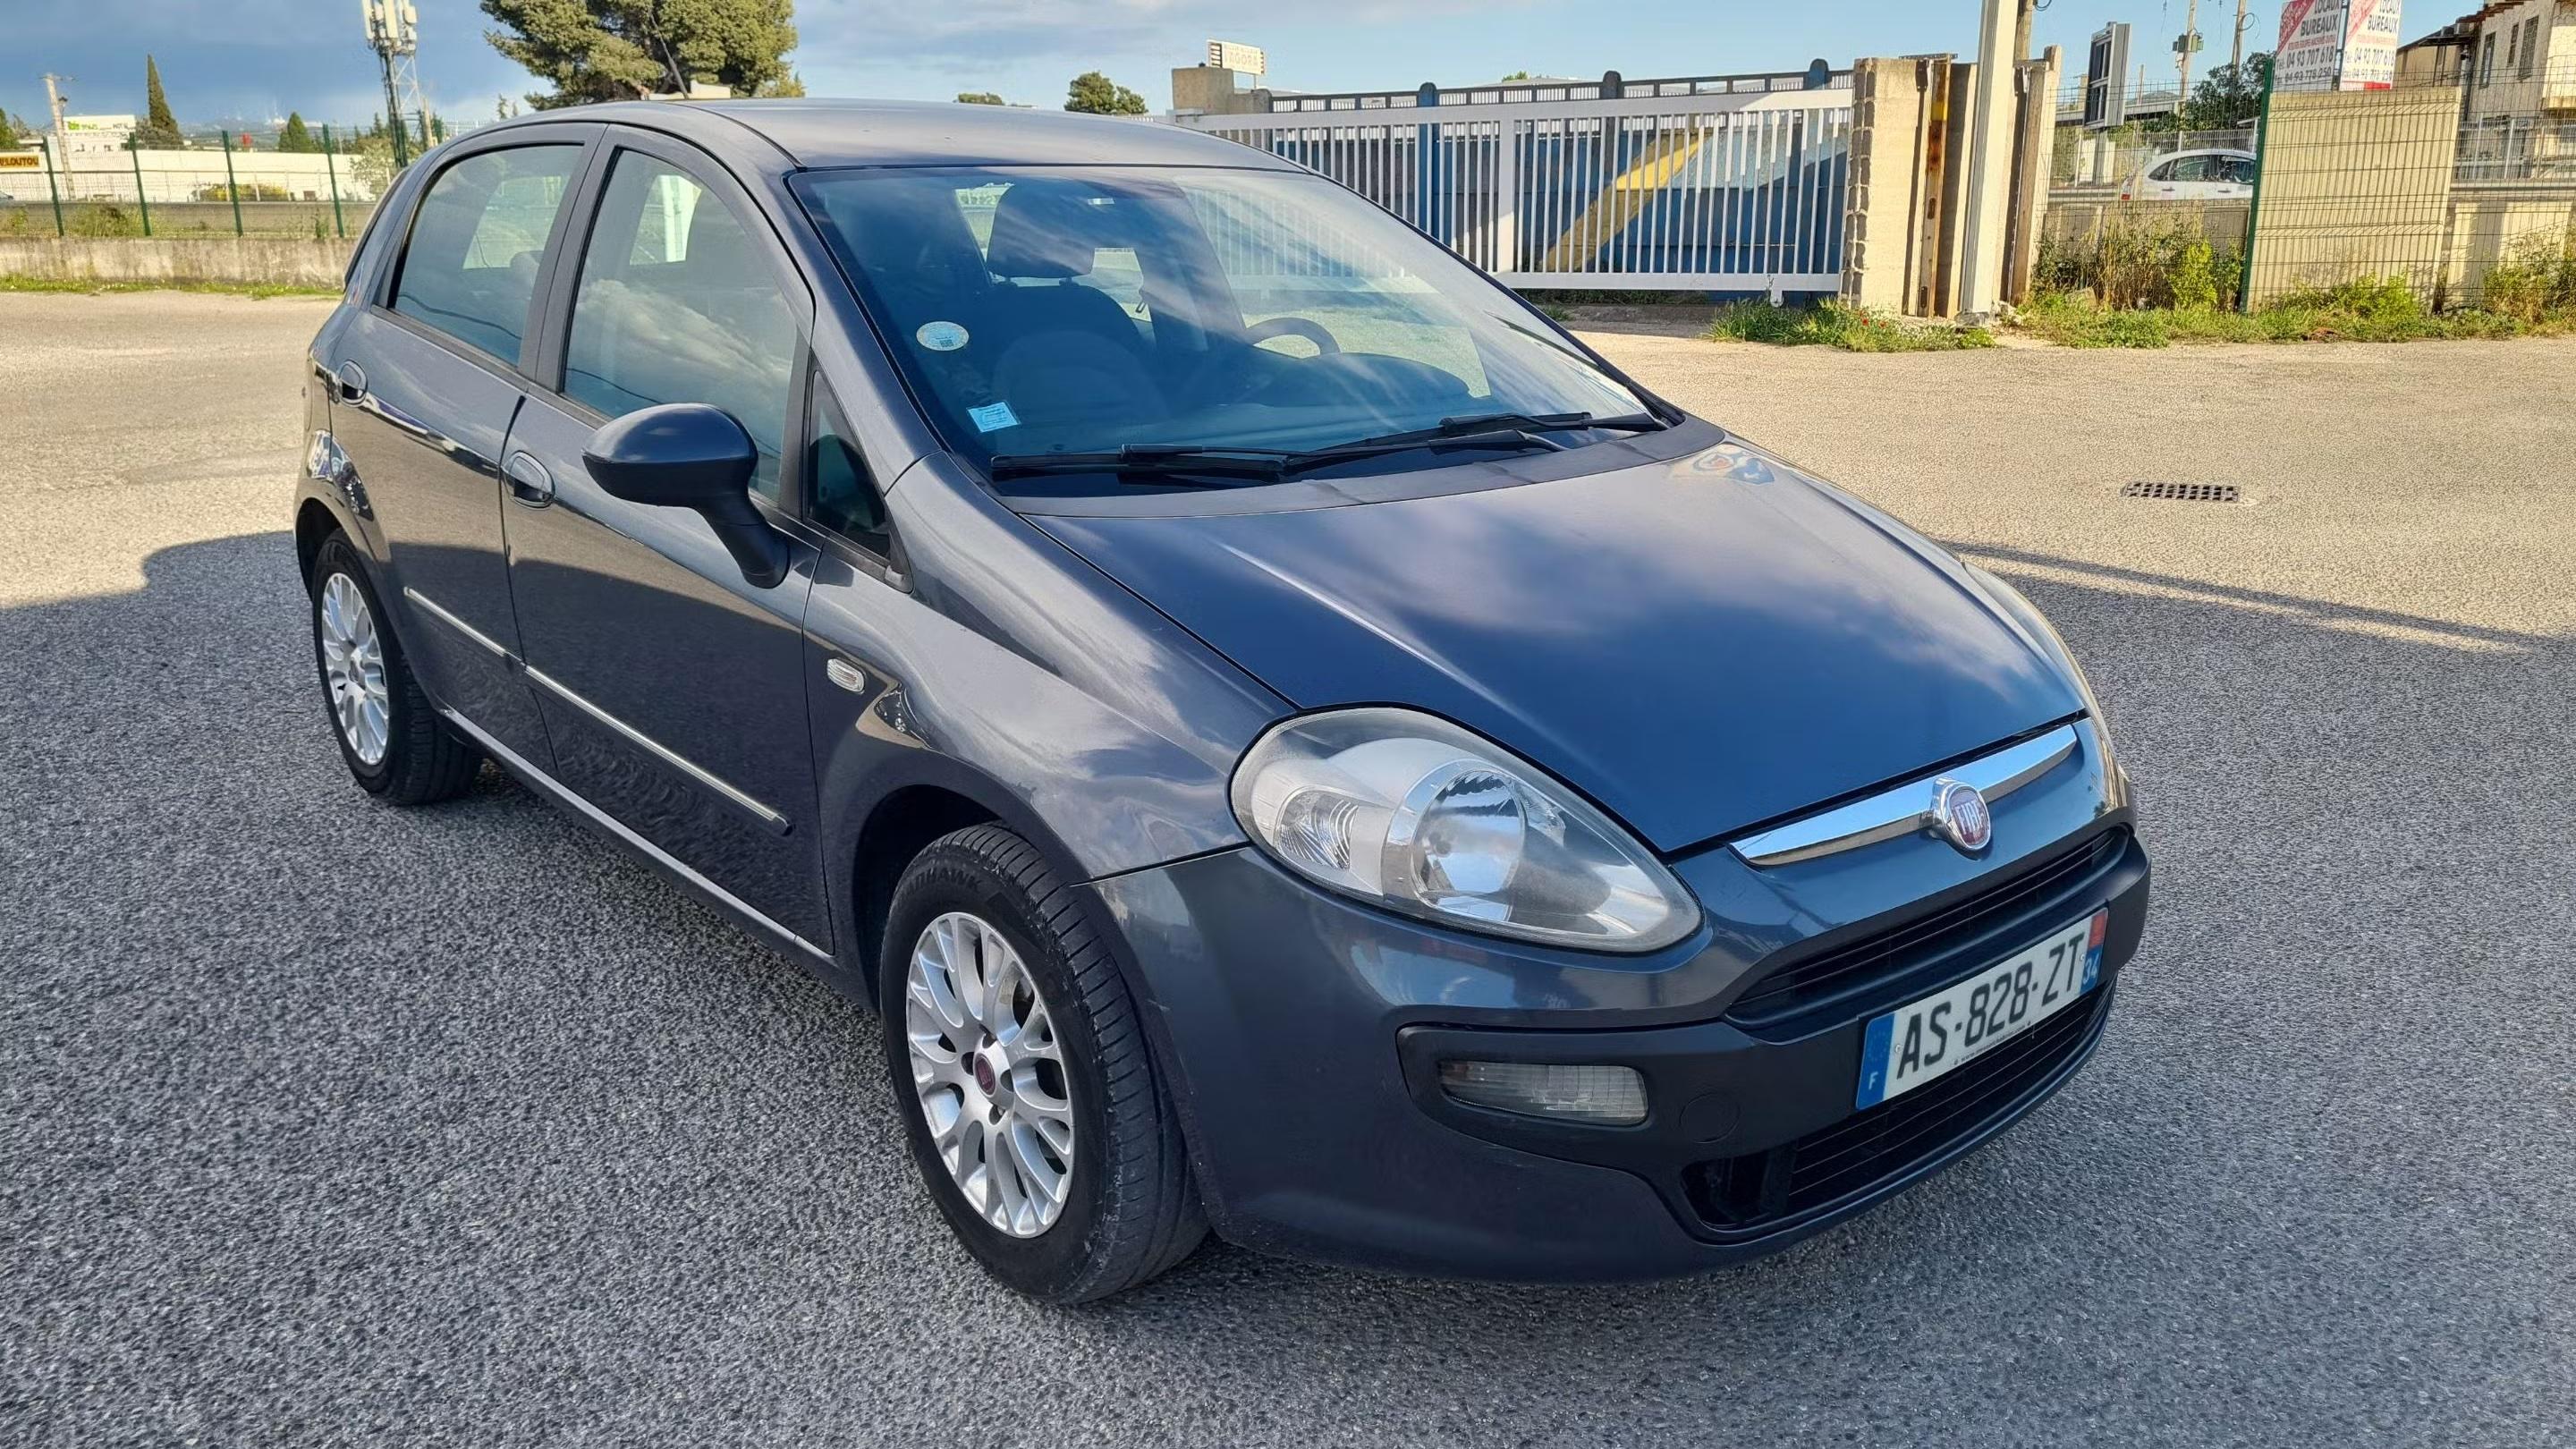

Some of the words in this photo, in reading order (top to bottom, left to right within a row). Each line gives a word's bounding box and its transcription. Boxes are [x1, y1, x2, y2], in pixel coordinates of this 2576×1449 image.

[2301, 14, 2338, 36] BUREAUX
[2368, 14, 2399, 33] BUREAUX
[2286, 52, 2295, 68] 04
[2297, 50, 2305, 66] 93
[2307, 48, 2319, 65] 707
[2320, 46, 2334, 64] 618
[2083, 954, 2099, 986] 34
[1896, 932, 2085, 1080] AS-828-ZT
[1868, 1073, 1877, 1091] F
